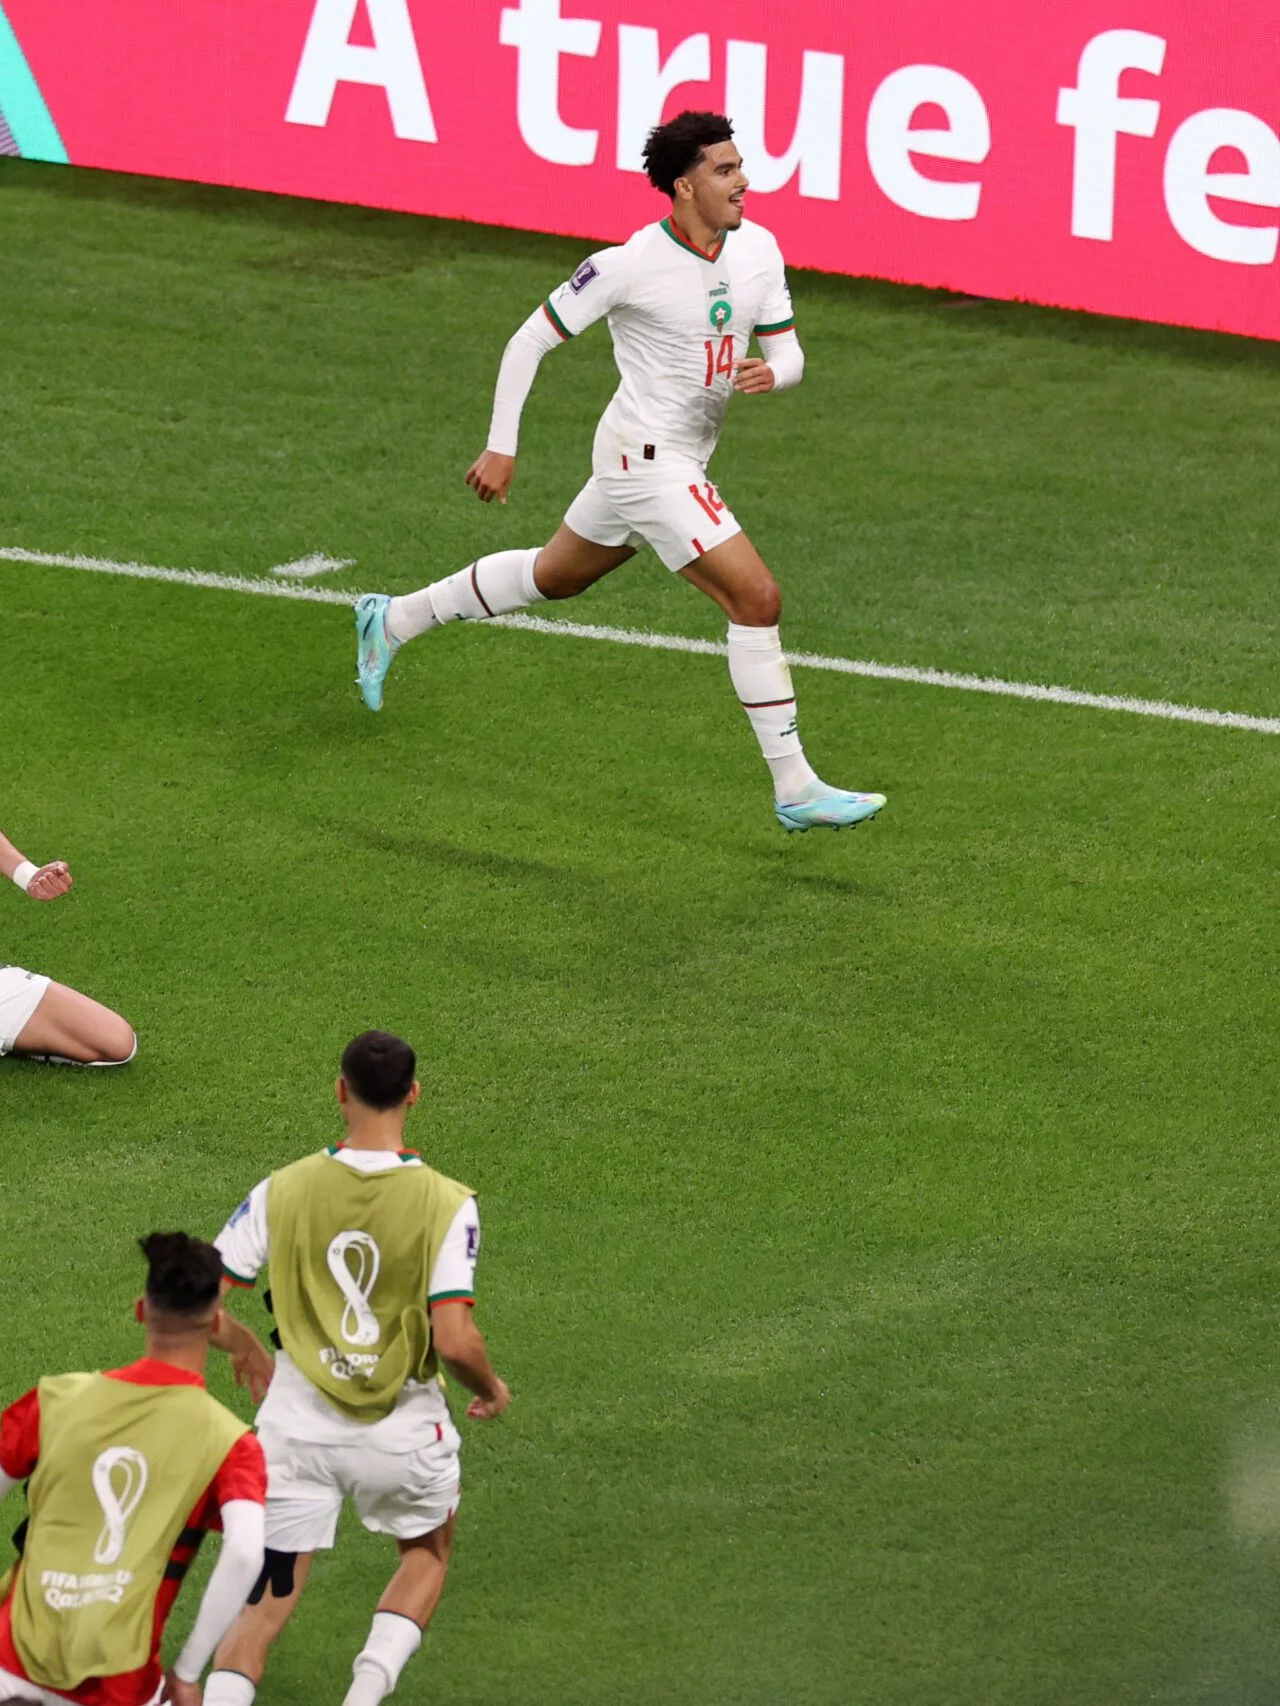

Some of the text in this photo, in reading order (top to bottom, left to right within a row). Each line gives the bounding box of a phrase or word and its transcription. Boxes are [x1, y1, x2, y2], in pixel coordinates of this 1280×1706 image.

[285, 0, 1280, 265] A true fe
[704, 335, 737, 387] 14
[40, 1569, 78, 1590] FIFA
